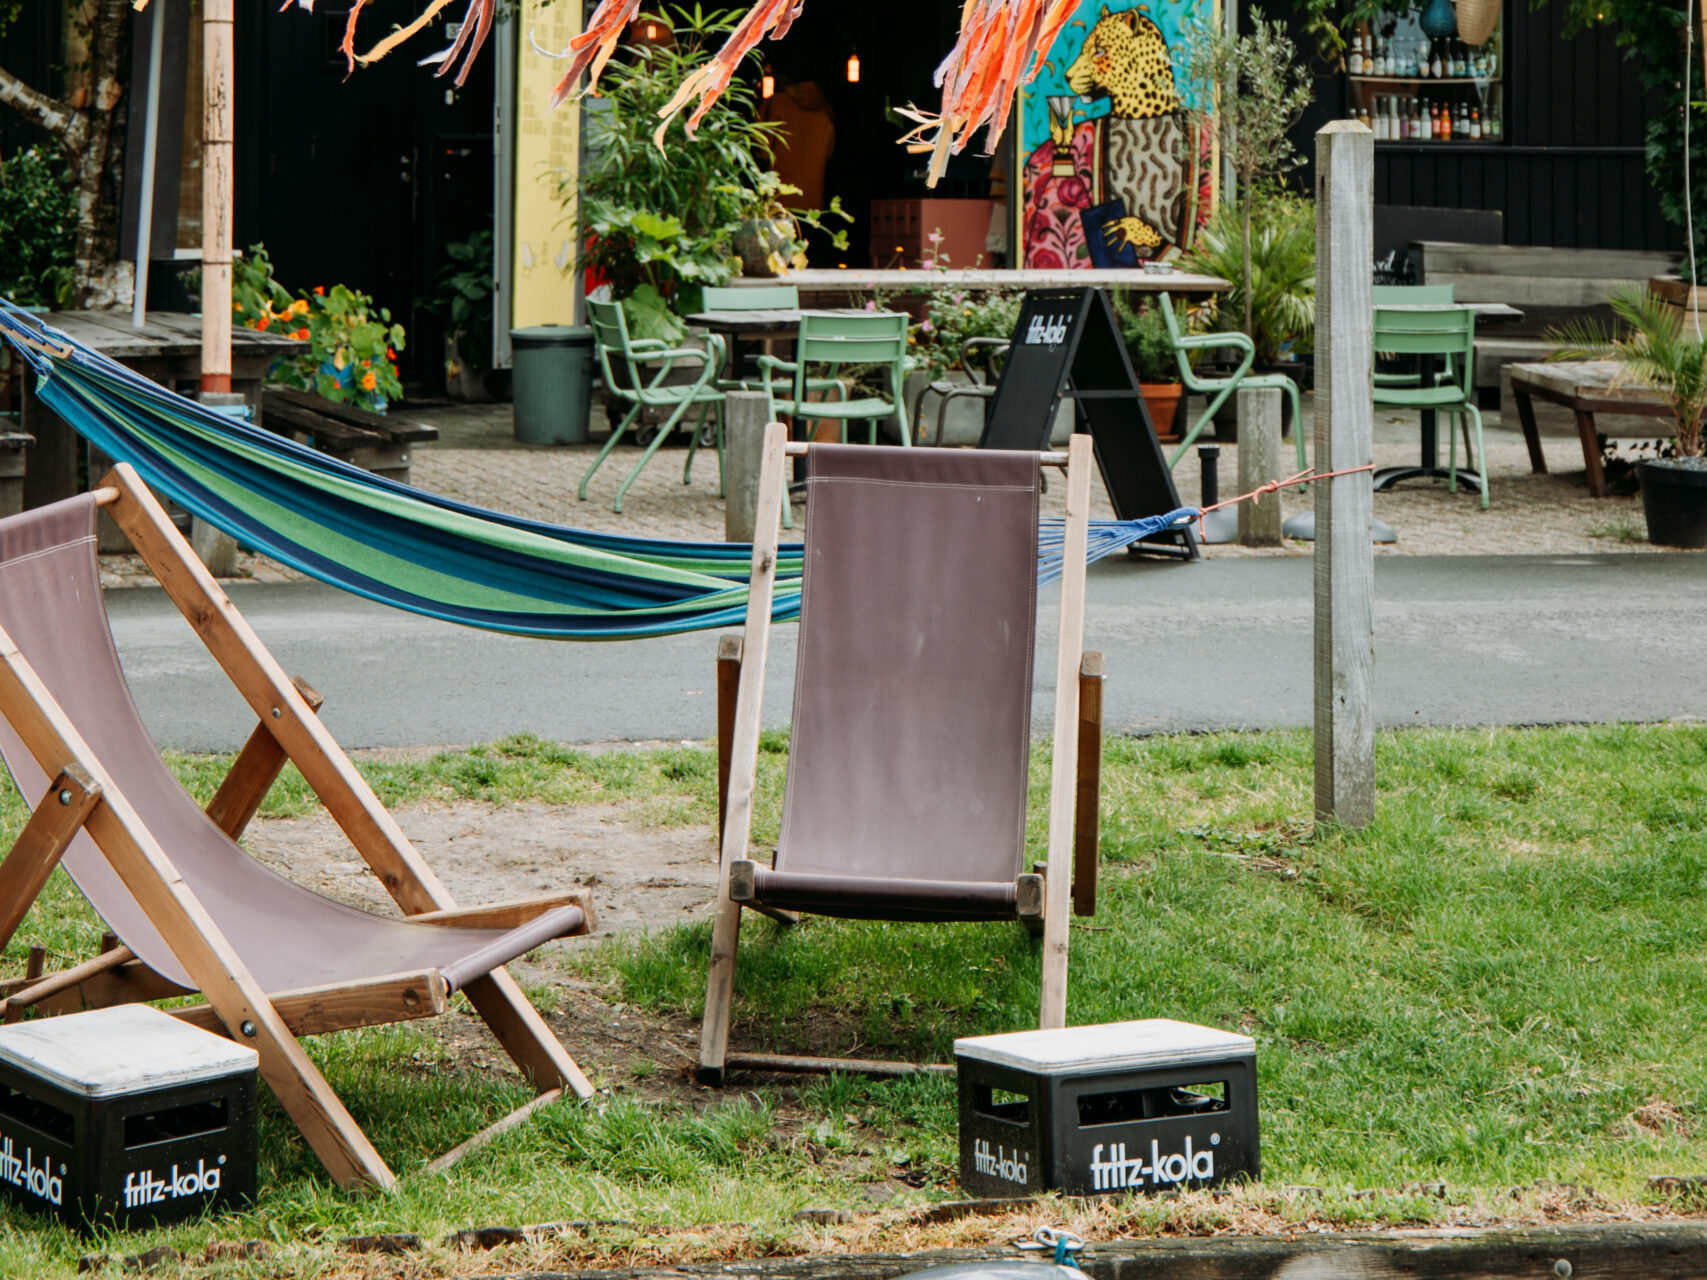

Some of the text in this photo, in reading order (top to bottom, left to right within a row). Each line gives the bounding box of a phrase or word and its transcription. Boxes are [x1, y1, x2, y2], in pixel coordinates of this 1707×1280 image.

[0, 1132, 62, 1206] ritz-kola
[123, 1159, 220, 1208] fritz-kola
[1090, 1135, 1214, 1190] fritz-kola
